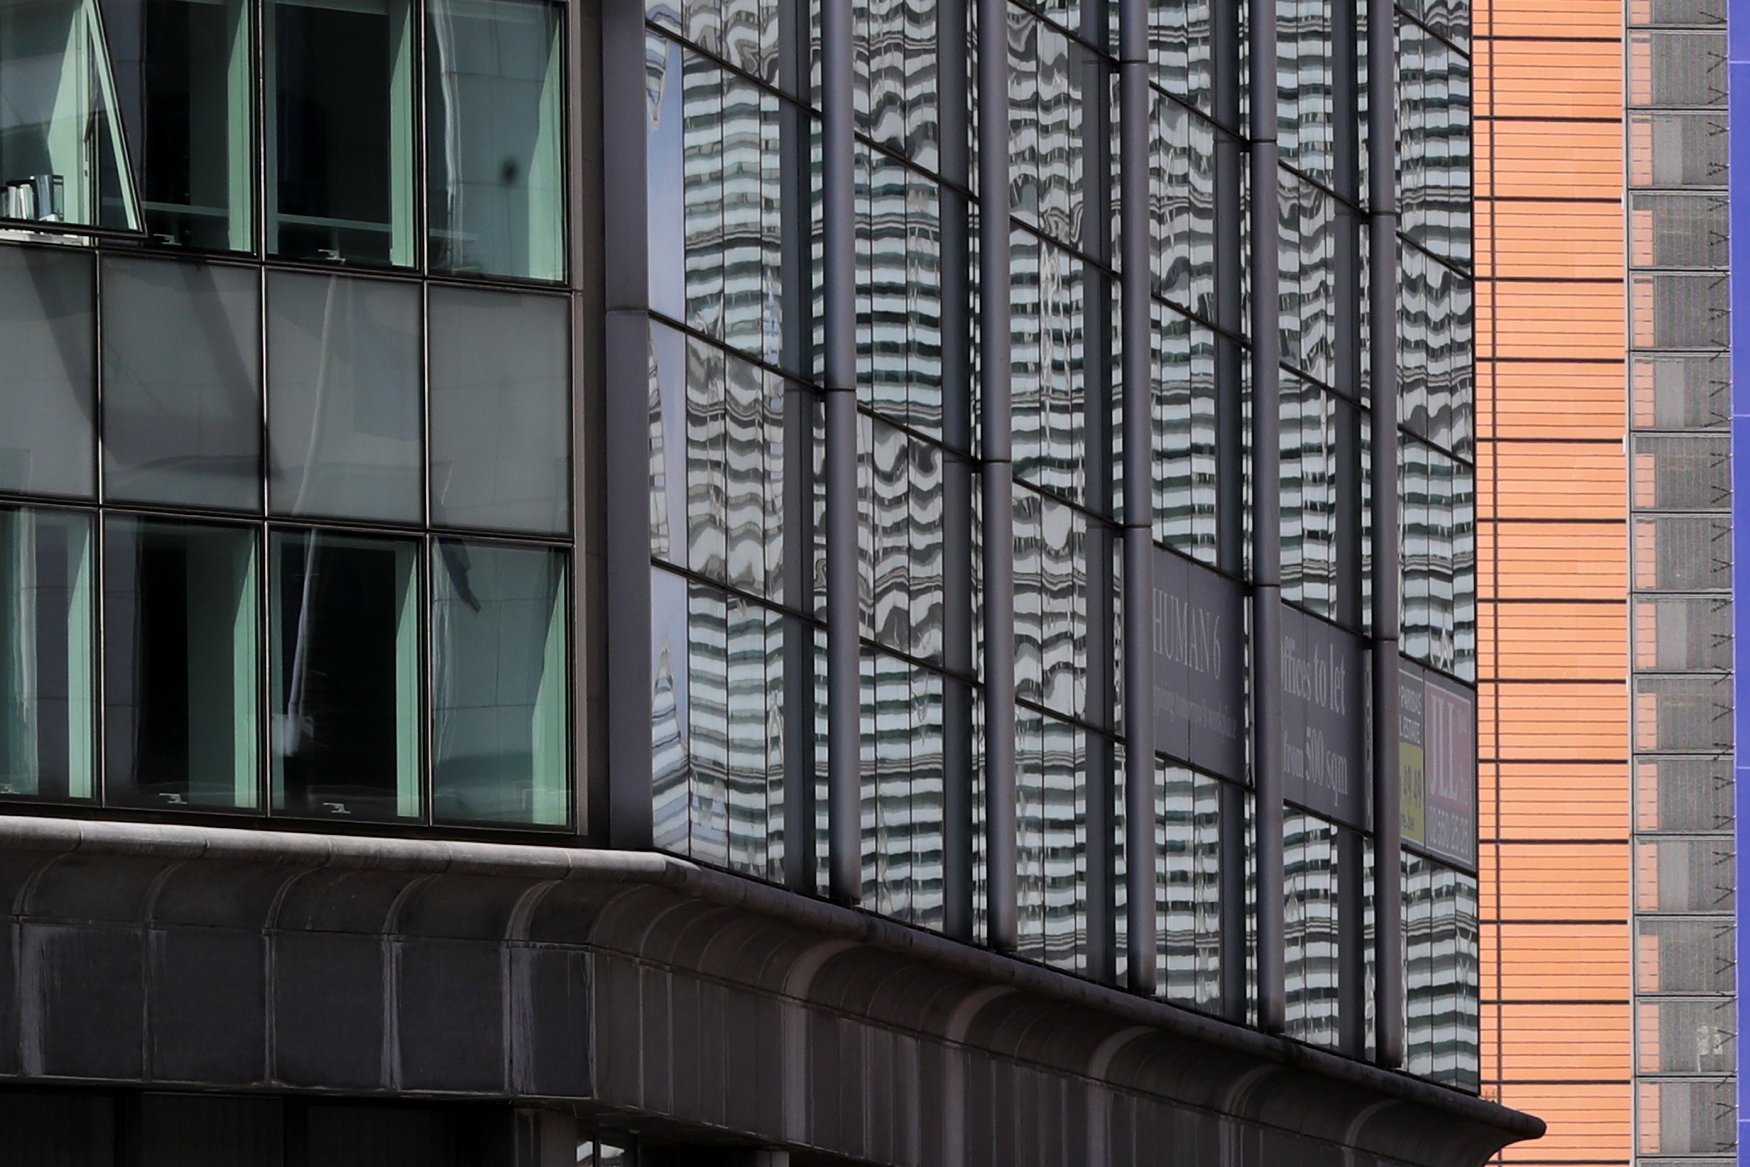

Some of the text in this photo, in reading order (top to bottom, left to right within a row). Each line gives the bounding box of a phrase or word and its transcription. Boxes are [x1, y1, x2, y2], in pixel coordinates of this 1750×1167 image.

[1152, 587, 1221, 681] HUMAN 6
[1280, 635, 1346, 716] ffices to let
[1305, 725, 1325, 787] 500
[1326, 749, 1349, 808] sqm
